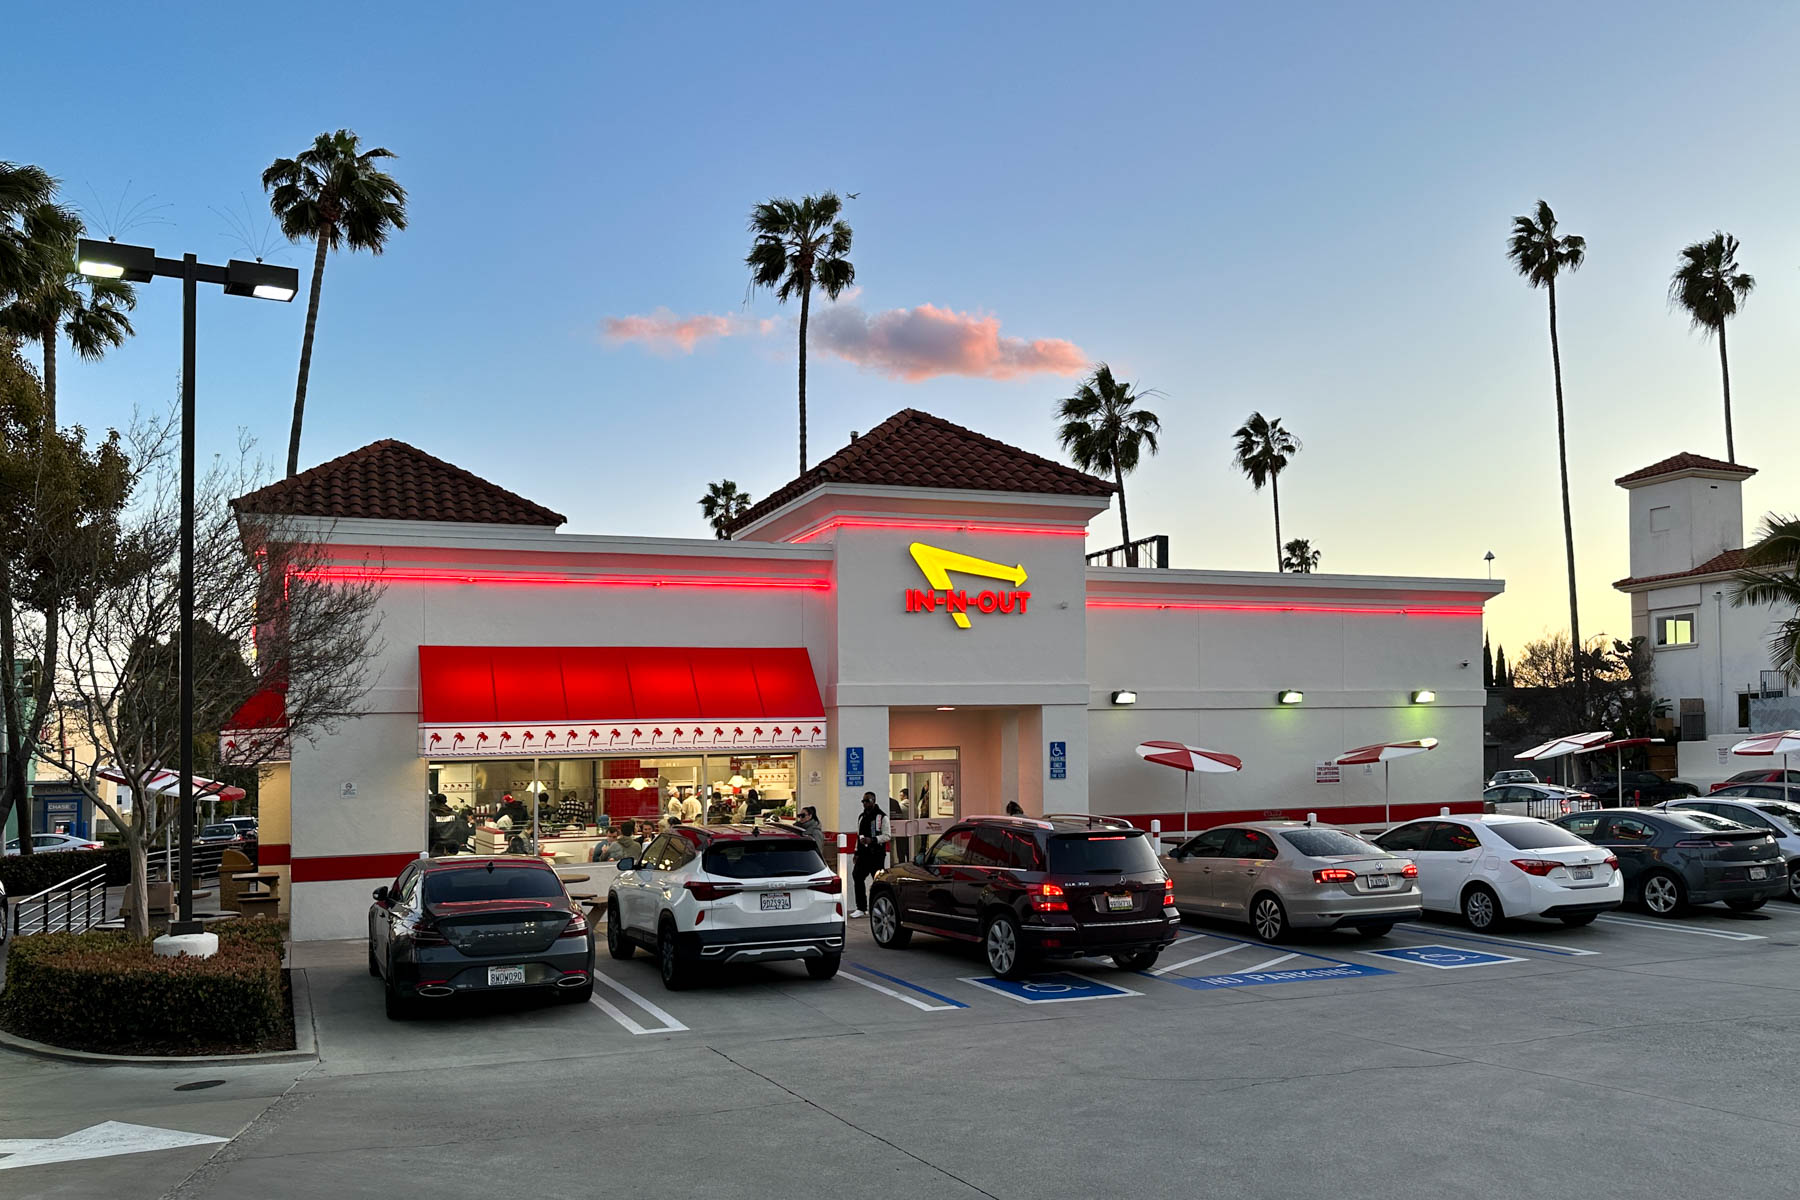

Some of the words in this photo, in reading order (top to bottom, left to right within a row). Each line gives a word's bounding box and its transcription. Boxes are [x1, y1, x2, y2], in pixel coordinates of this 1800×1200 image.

[905, 589, 1032, 614] IN-N-OUT
[1200, 977, 1244, 986] NO
[1246, 968, 1364, 982] PARKING
